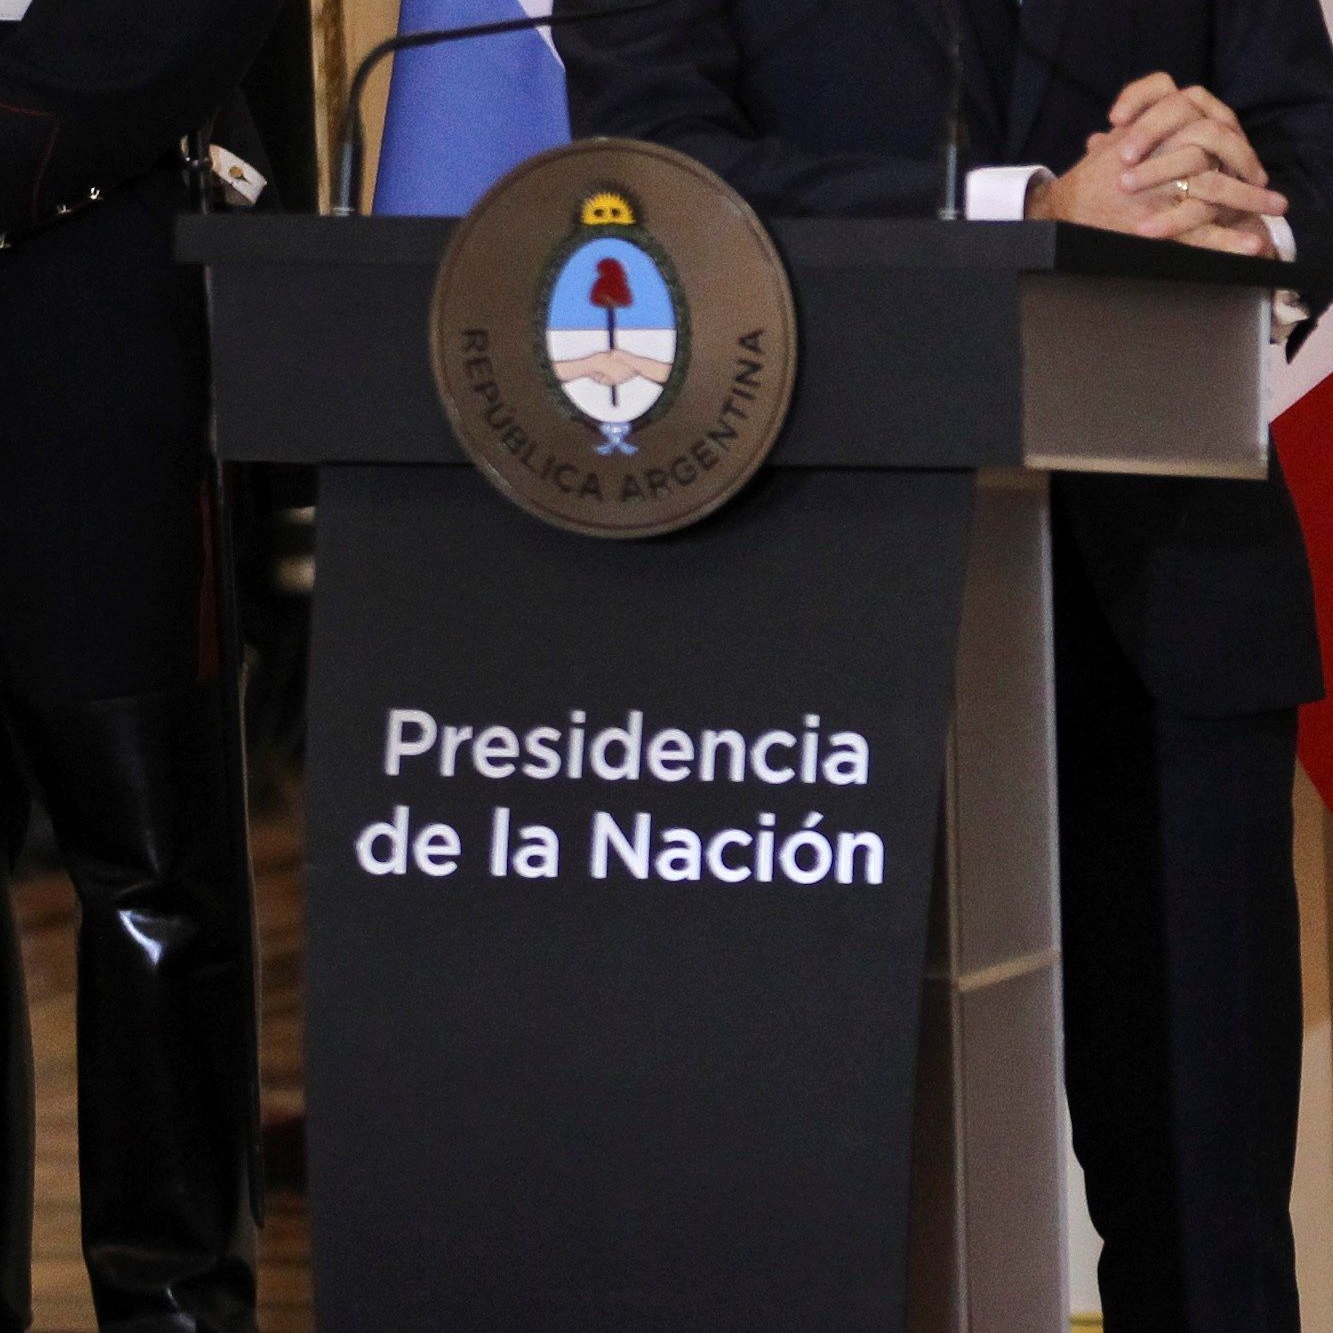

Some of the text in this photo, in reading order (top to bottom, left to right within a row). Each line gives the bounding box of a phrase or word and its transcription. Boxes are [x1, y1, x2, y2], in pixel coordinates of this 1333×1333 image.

[619, 330, 766, 502] ARGENTINA
[384, 709, 870, 785] Presidencia
[355, 804, 884, 885] de la Nación
